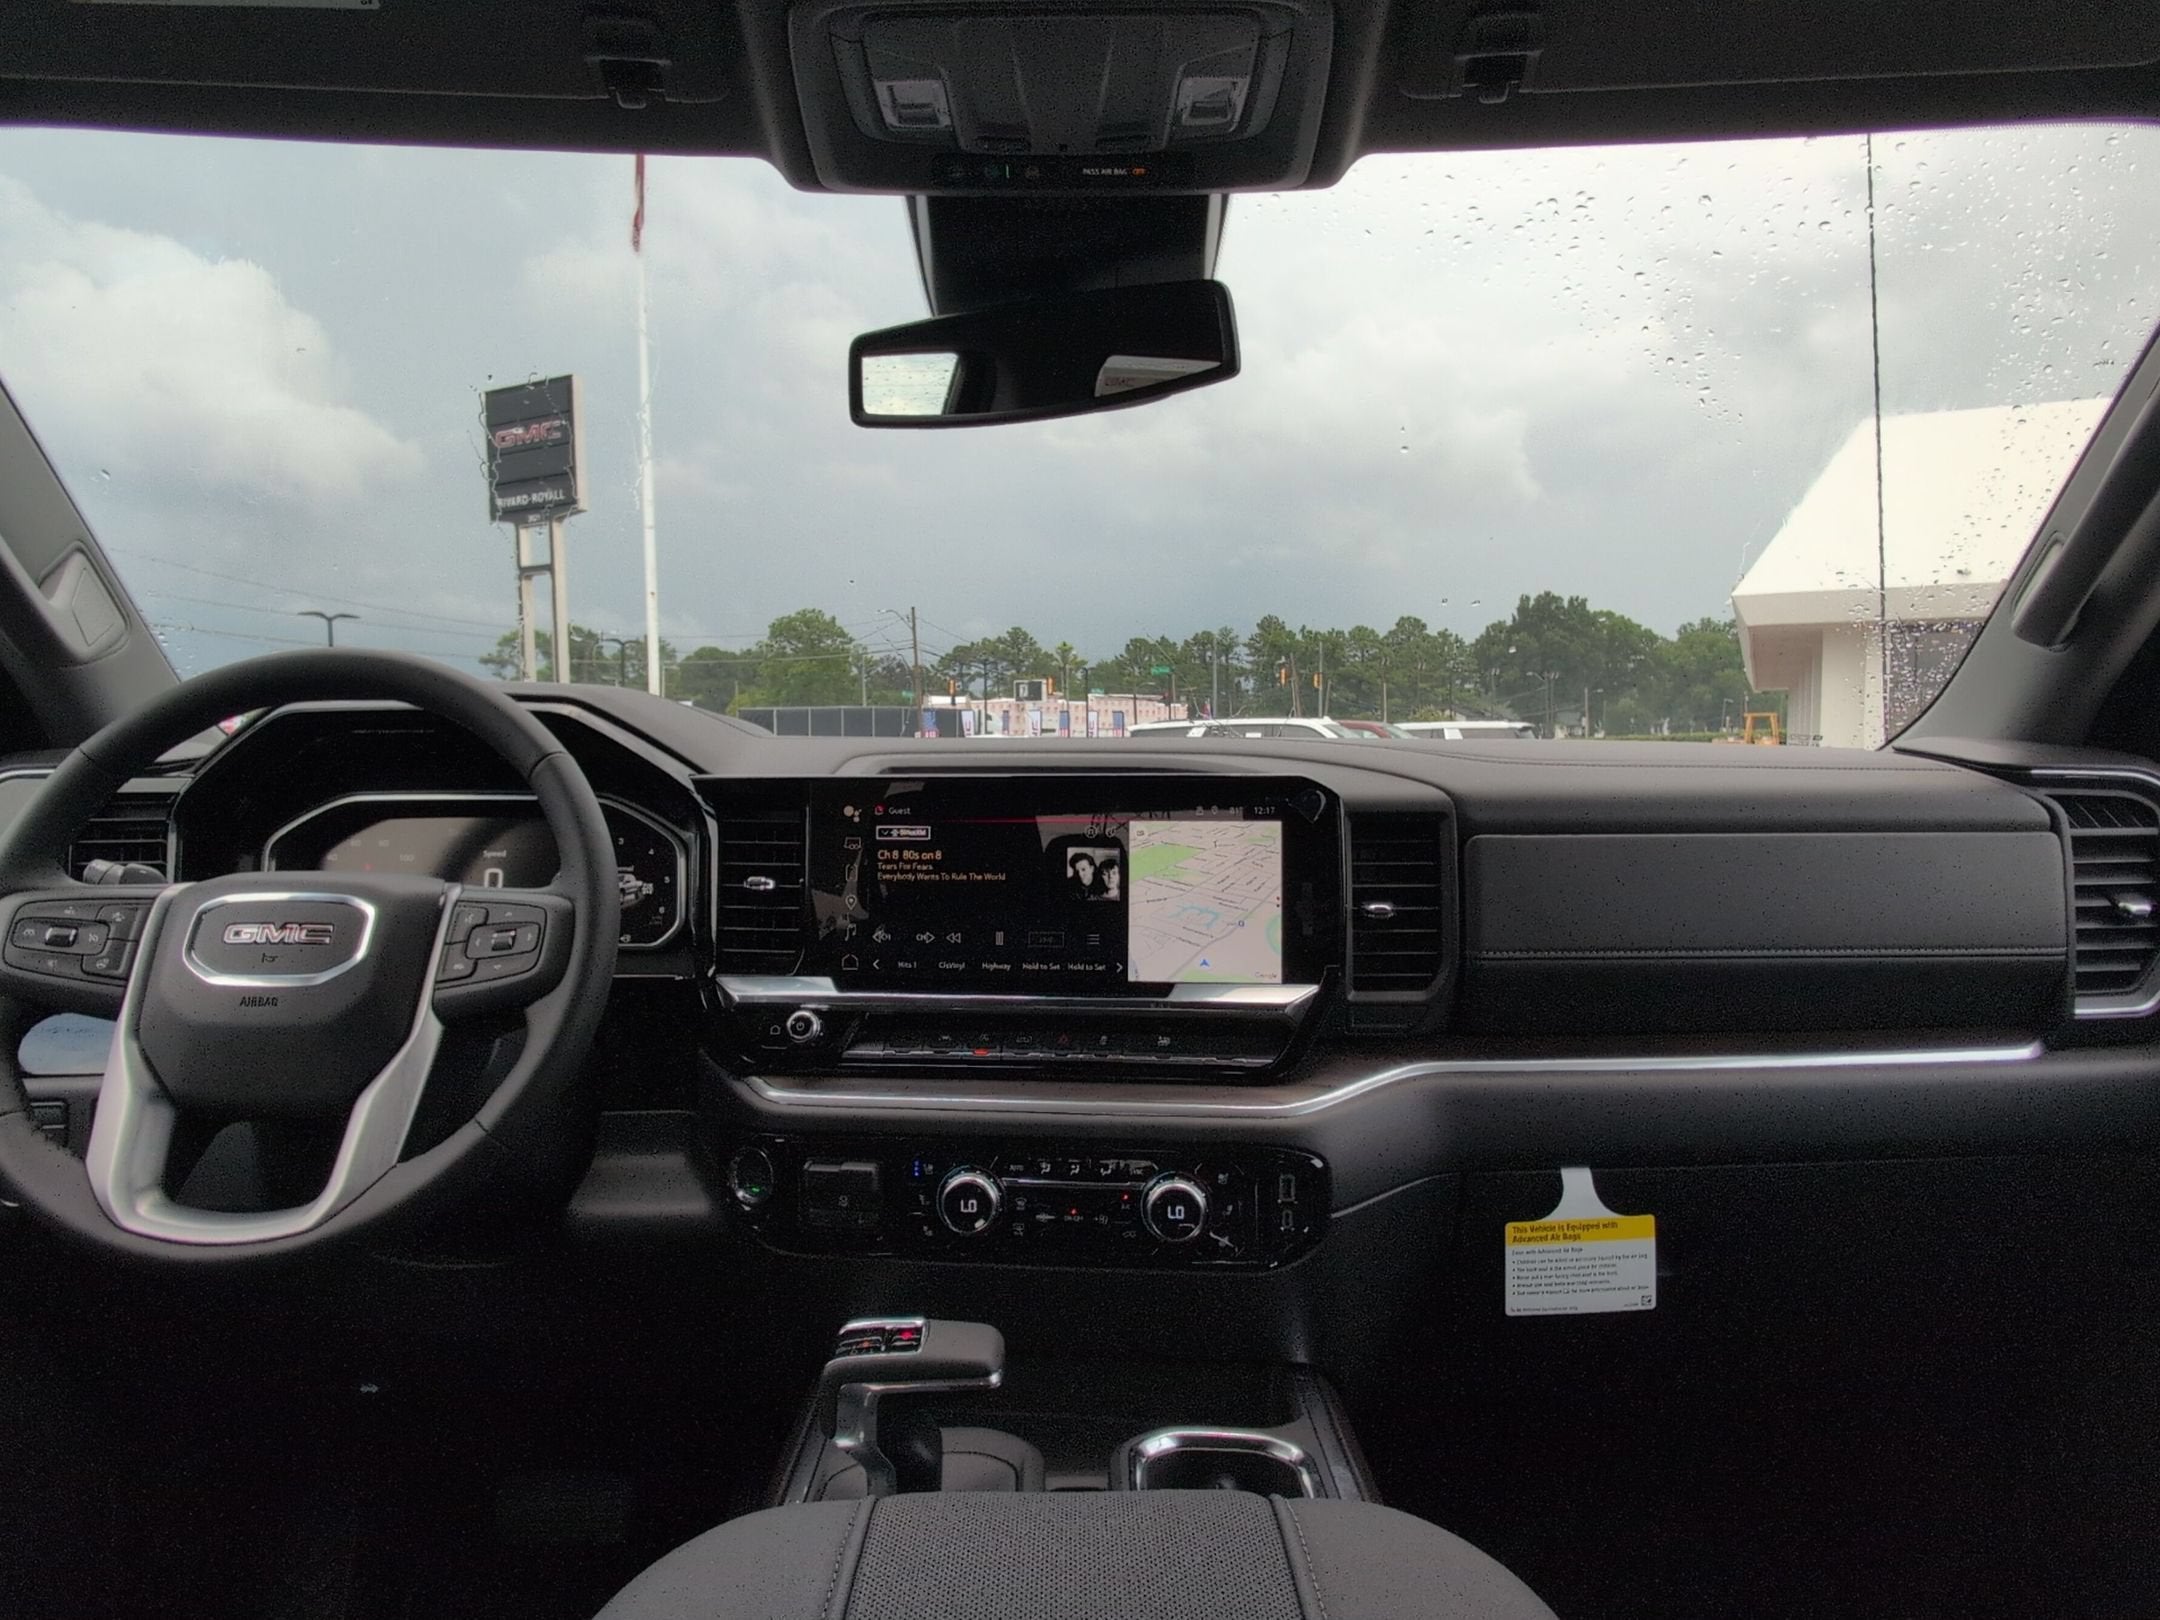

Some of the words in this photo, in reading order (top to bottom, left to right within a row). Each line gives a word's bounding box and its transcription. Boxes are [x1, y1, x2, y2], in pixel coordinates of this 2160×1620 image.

[495, 420, 560, 447] GMC
[888, 807, 911, 815] Guest
[1254, 806, 1276, 815] 12:17
[482, 850, 508, 859] Speed
[877, 849, 891, 860] Ch
[892, 850, 899, 860] 8
[902, 850, 920, 860] 80s
[921, 852, 934, 860] on
[935, 850, 942, 860] 8
[877, 862, 898, 870] Tears
[912, 862, 934, 870] Fears
[877, 872, 916, 882] Everybody
[917, 872, 940, 880] Wants
[940, 872, 949, 880] To
[952, 872, 968, 880] Rule
[970, 872, 983, 880] The
[984, 872, 1006, 881] World
[223, 922, 335, 945] GMC
[982, 961, 1012, 972] Highway
[1022, 962, 1039, 970] Hold
[1048, 962, 1060, 970] Set
[1068, 962, 1084, 971] Hold
[1094, 963, 1106, 972] Set
[239, 996, 279, 1007] AIRBAG
[1512, 1226, 1528, 1234] This
[1529, 1224, 1556, 1233] Vehicle
[1558, 1224, 1565, 1232] is
[1566, 1222, 1601, 1232] Equipped
[1602, 1221, 1618, 1230] with
[1512, 1234, 1548, 1244] Advanced
[1562, 1232, 1582, 1242] Bags
